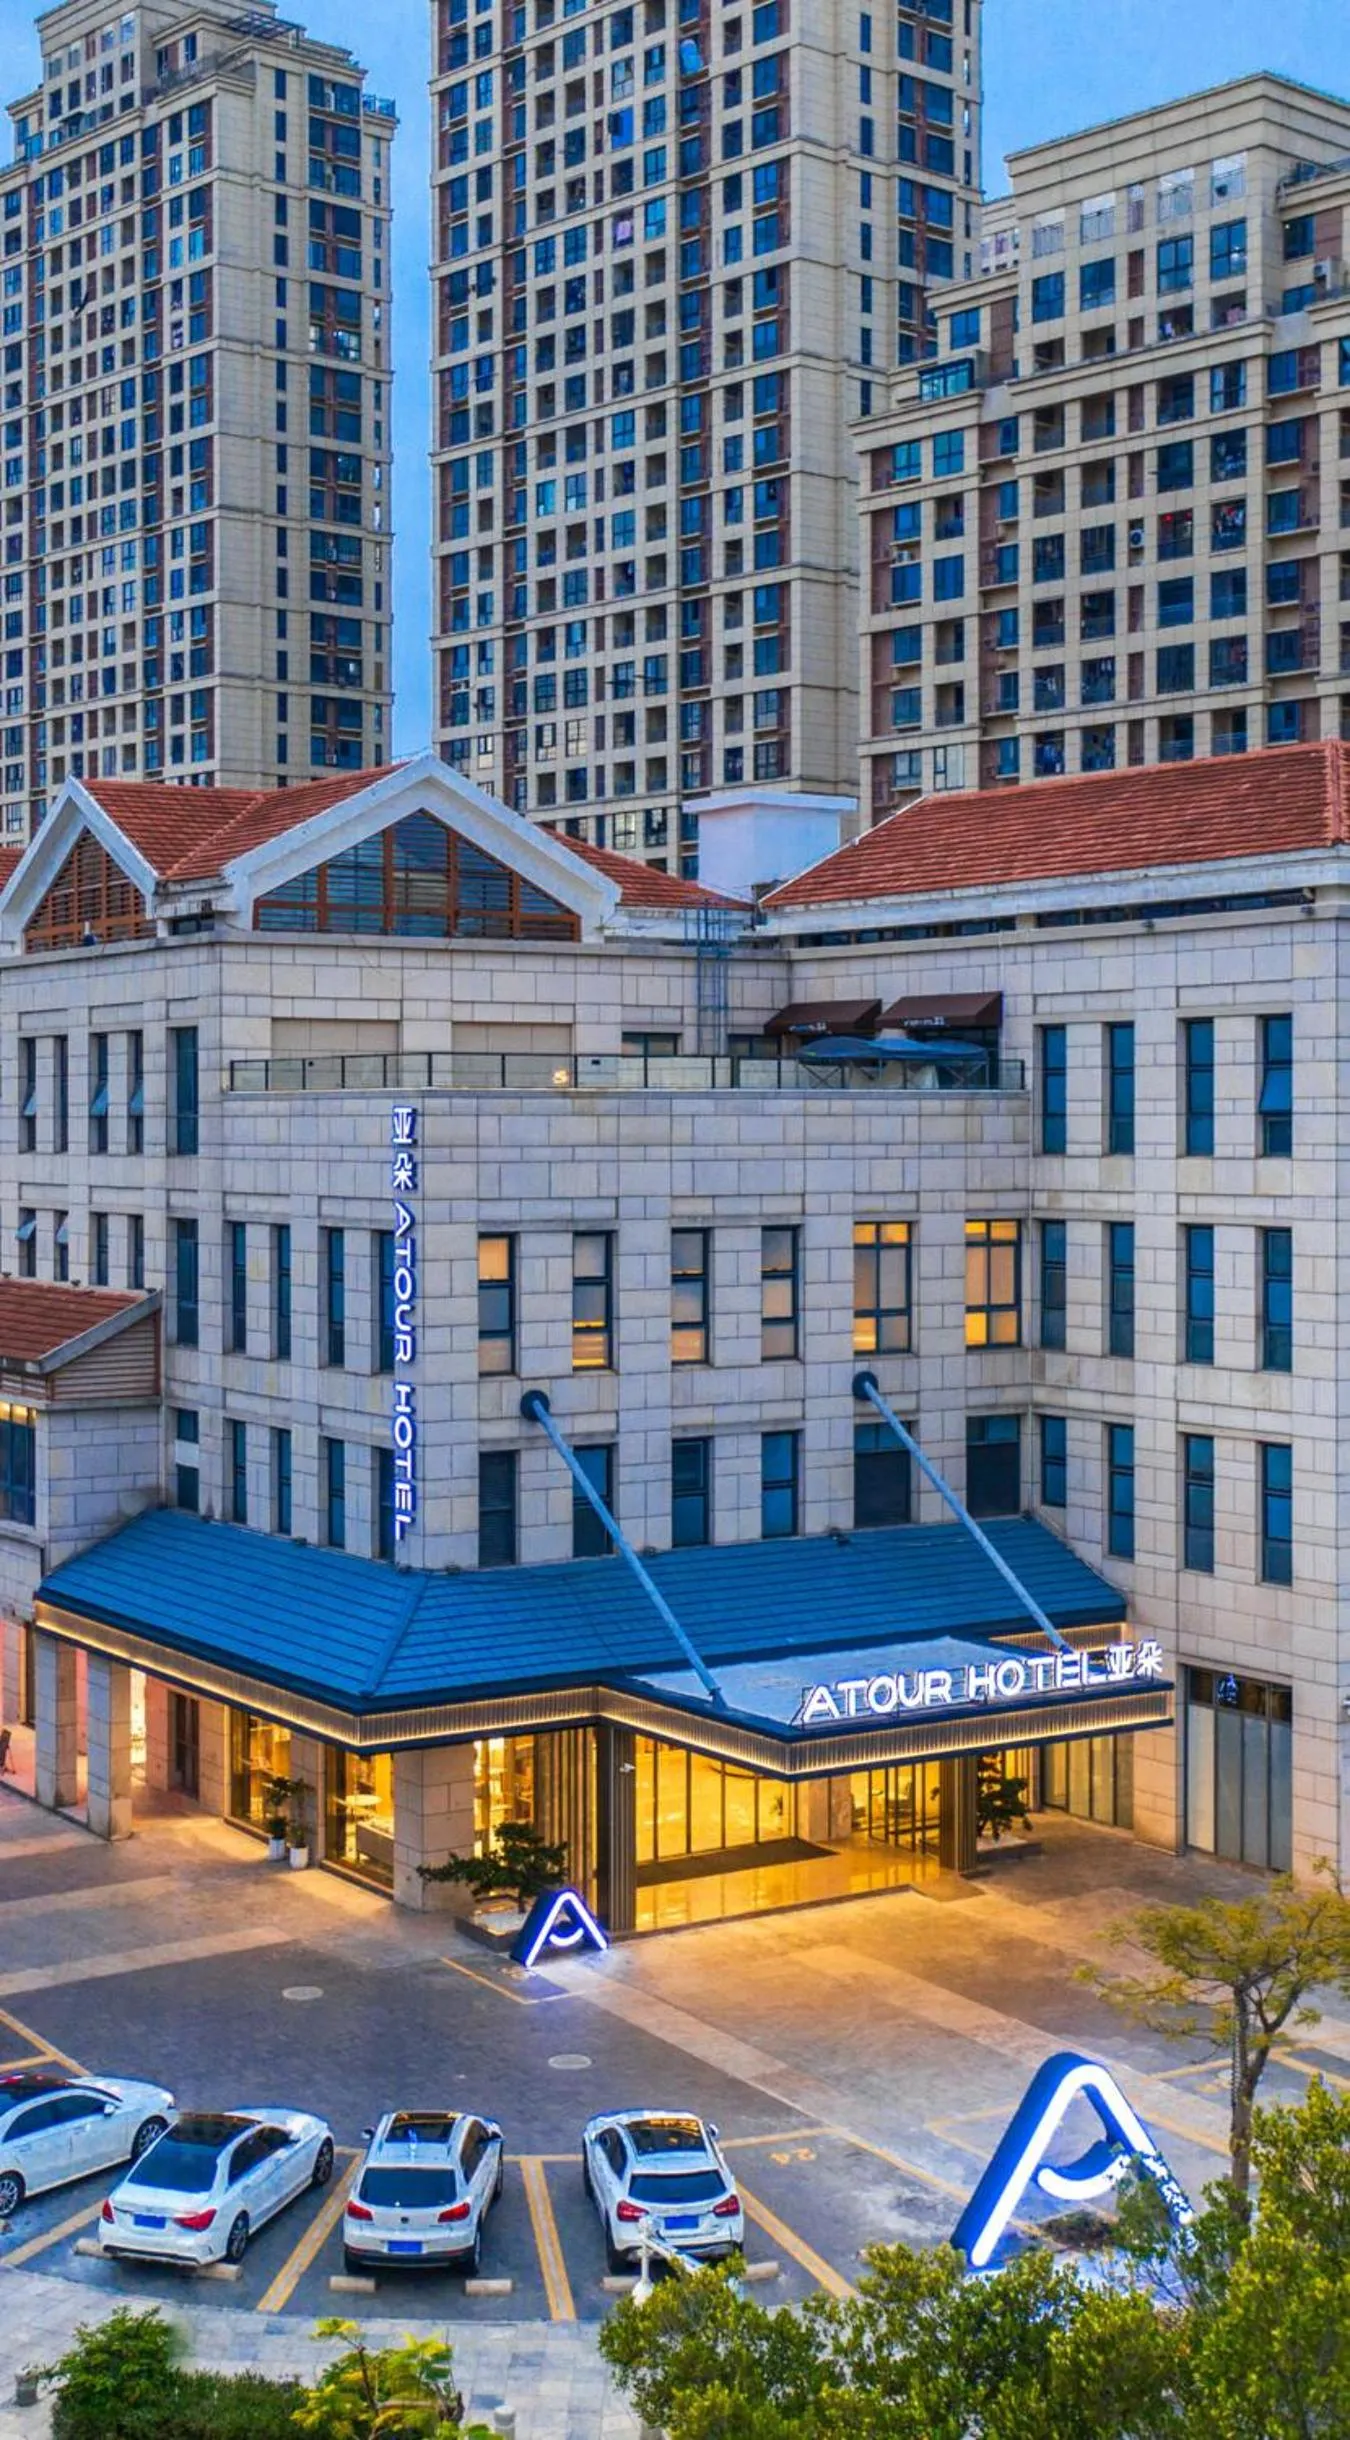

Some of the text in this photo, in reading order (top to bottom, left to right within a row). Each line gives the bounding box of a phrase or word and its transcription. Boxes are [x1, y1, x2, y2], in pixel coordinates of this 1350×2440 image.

[393, 1107, 415, 1541] 亚朵 ATOUR HOTEL
[802, 1640, 1164, 1723] ATOUR HOTEL 亚朵
